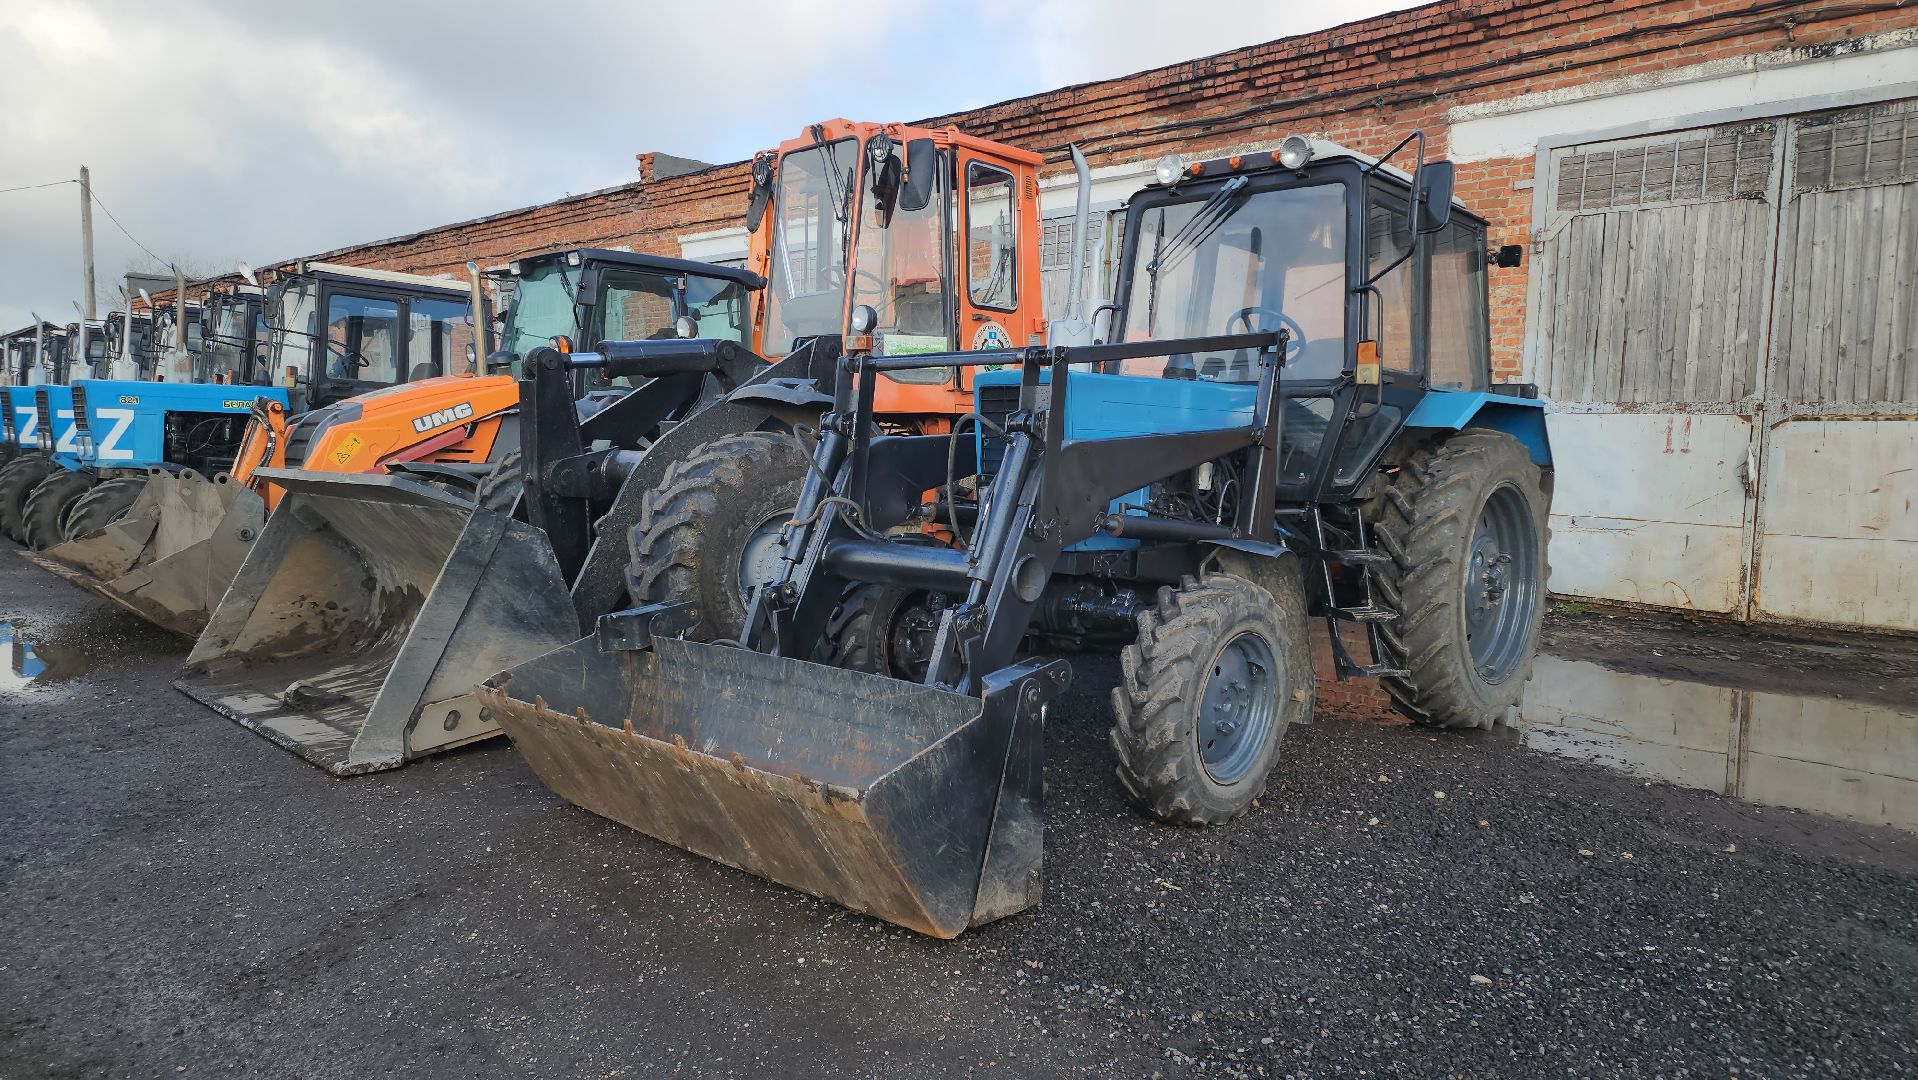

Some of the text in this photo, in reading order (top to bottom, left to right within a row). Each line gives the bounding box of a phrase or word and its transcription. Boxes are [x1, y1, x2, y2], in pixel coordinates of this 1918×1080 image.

[16, 406, 39, 444] Z
[56, 409, 79, 453] Z
[96, 408, 135, 460] Z
[412, 403, 473, 433] UMG
